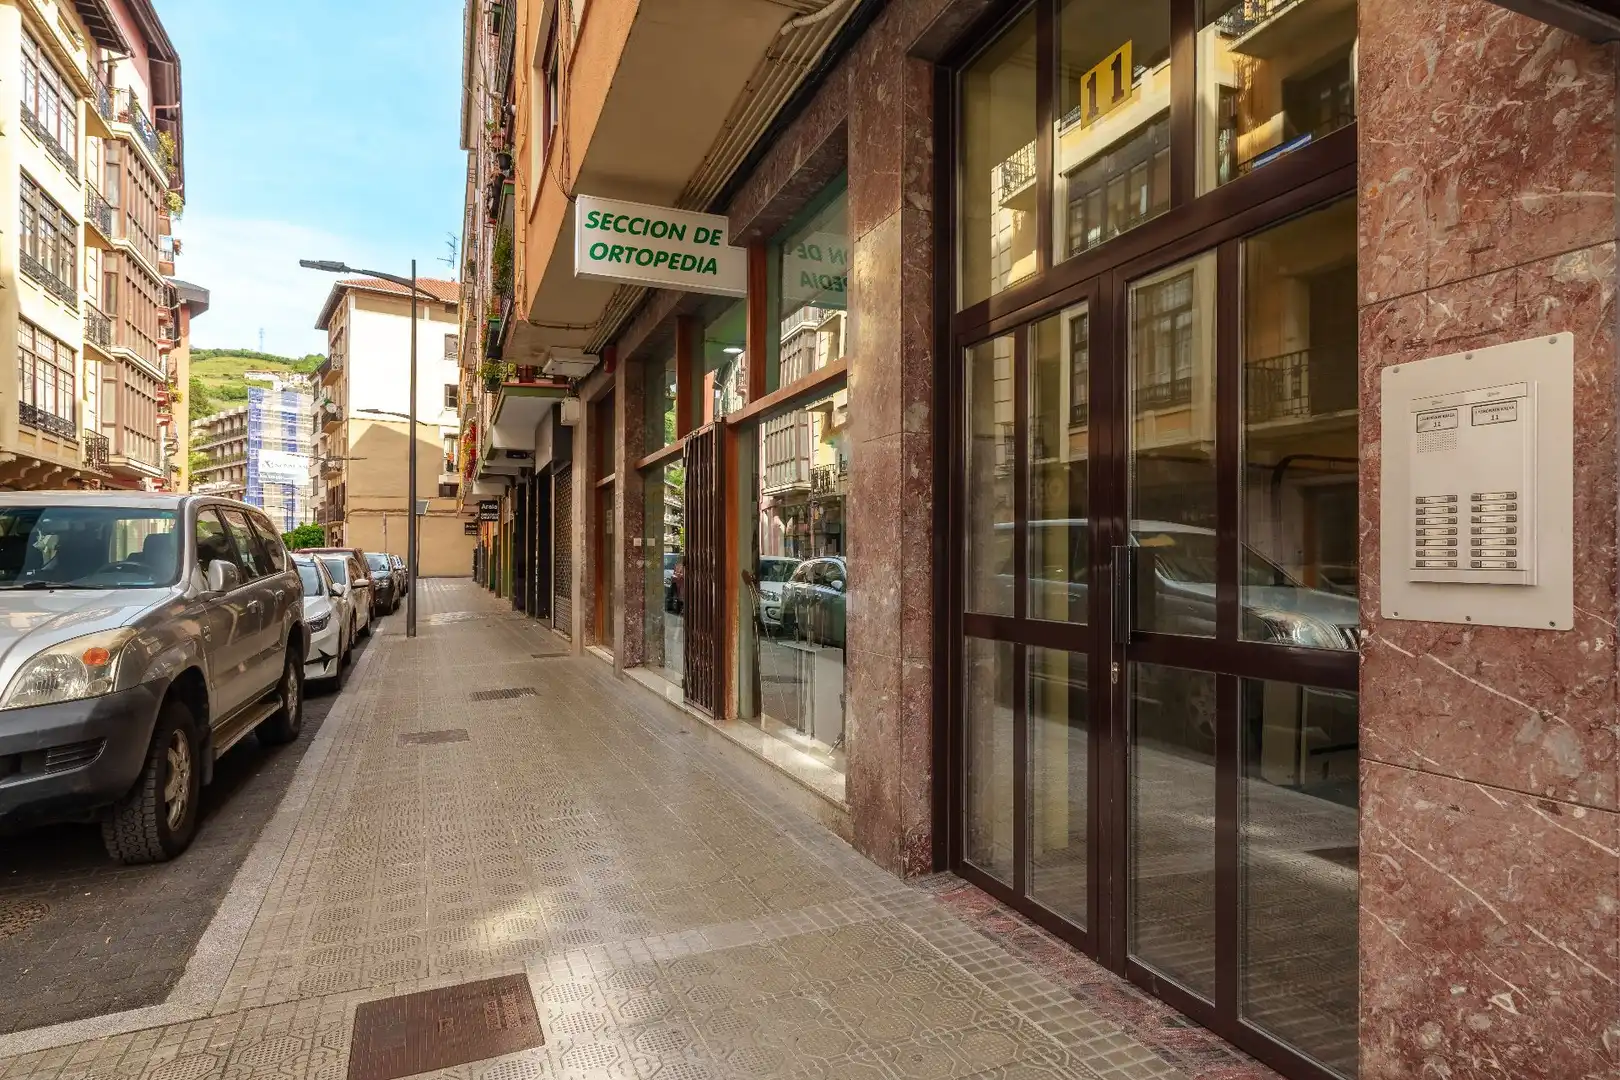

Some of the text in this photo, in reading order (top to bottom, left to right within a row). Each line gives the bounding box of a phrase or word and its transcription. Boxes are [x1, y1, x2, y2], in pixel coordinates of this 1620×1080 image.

[1086, 51, 1125, 121] 11
[584, 210, 723, 247] SECCION DE
[588, 242, 718, 276] ORTOPEDIA
